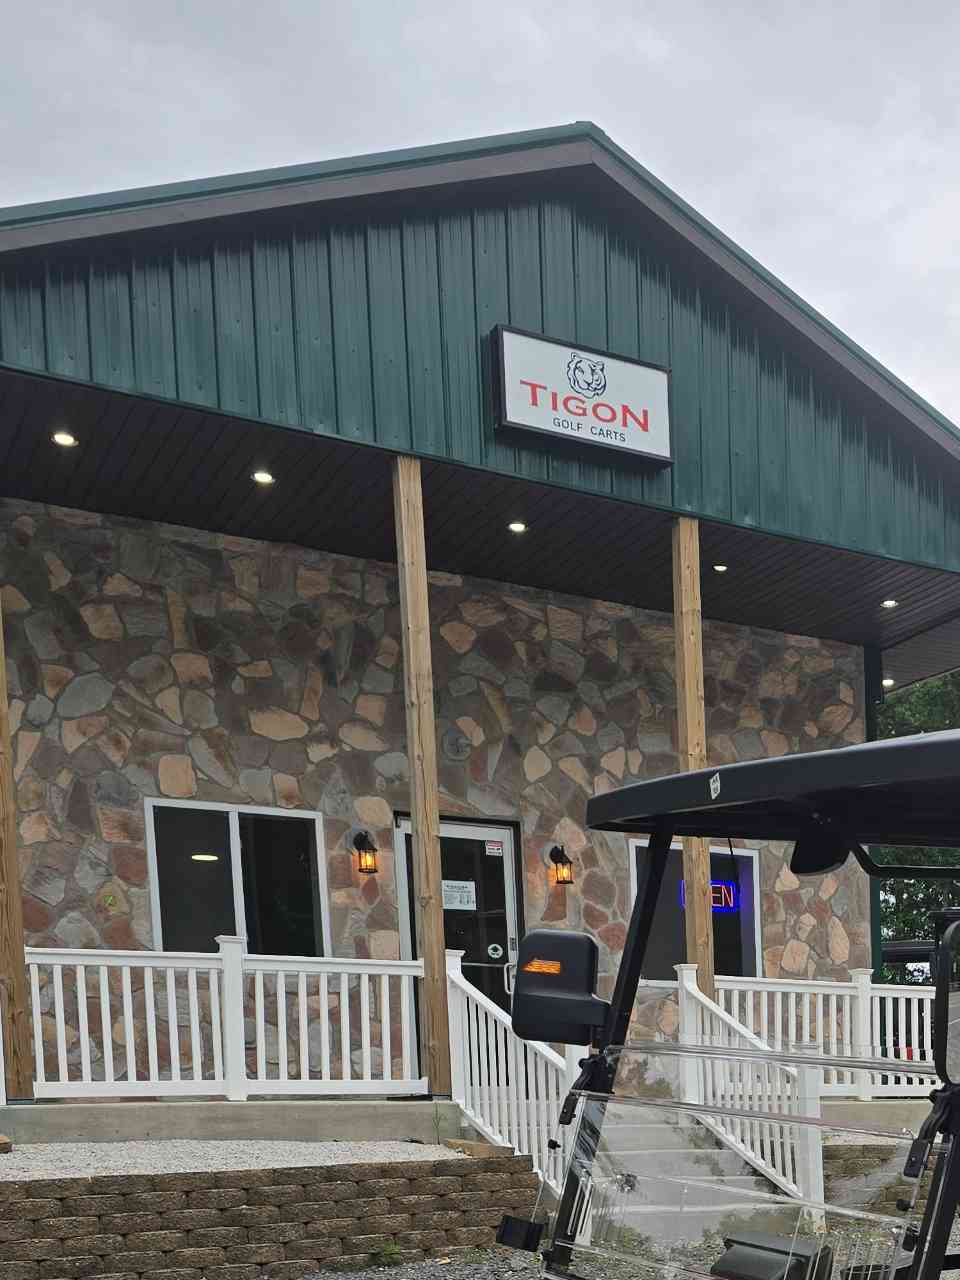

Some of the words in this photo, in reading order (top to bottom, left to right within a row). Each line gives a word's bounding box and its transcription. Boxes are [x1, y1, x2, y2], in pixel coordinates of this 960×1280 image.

[520, 379, 649, 432] TIGON
[553, 417, 583, 432] GOLF
[590, 426, 626, 442] CARTS
